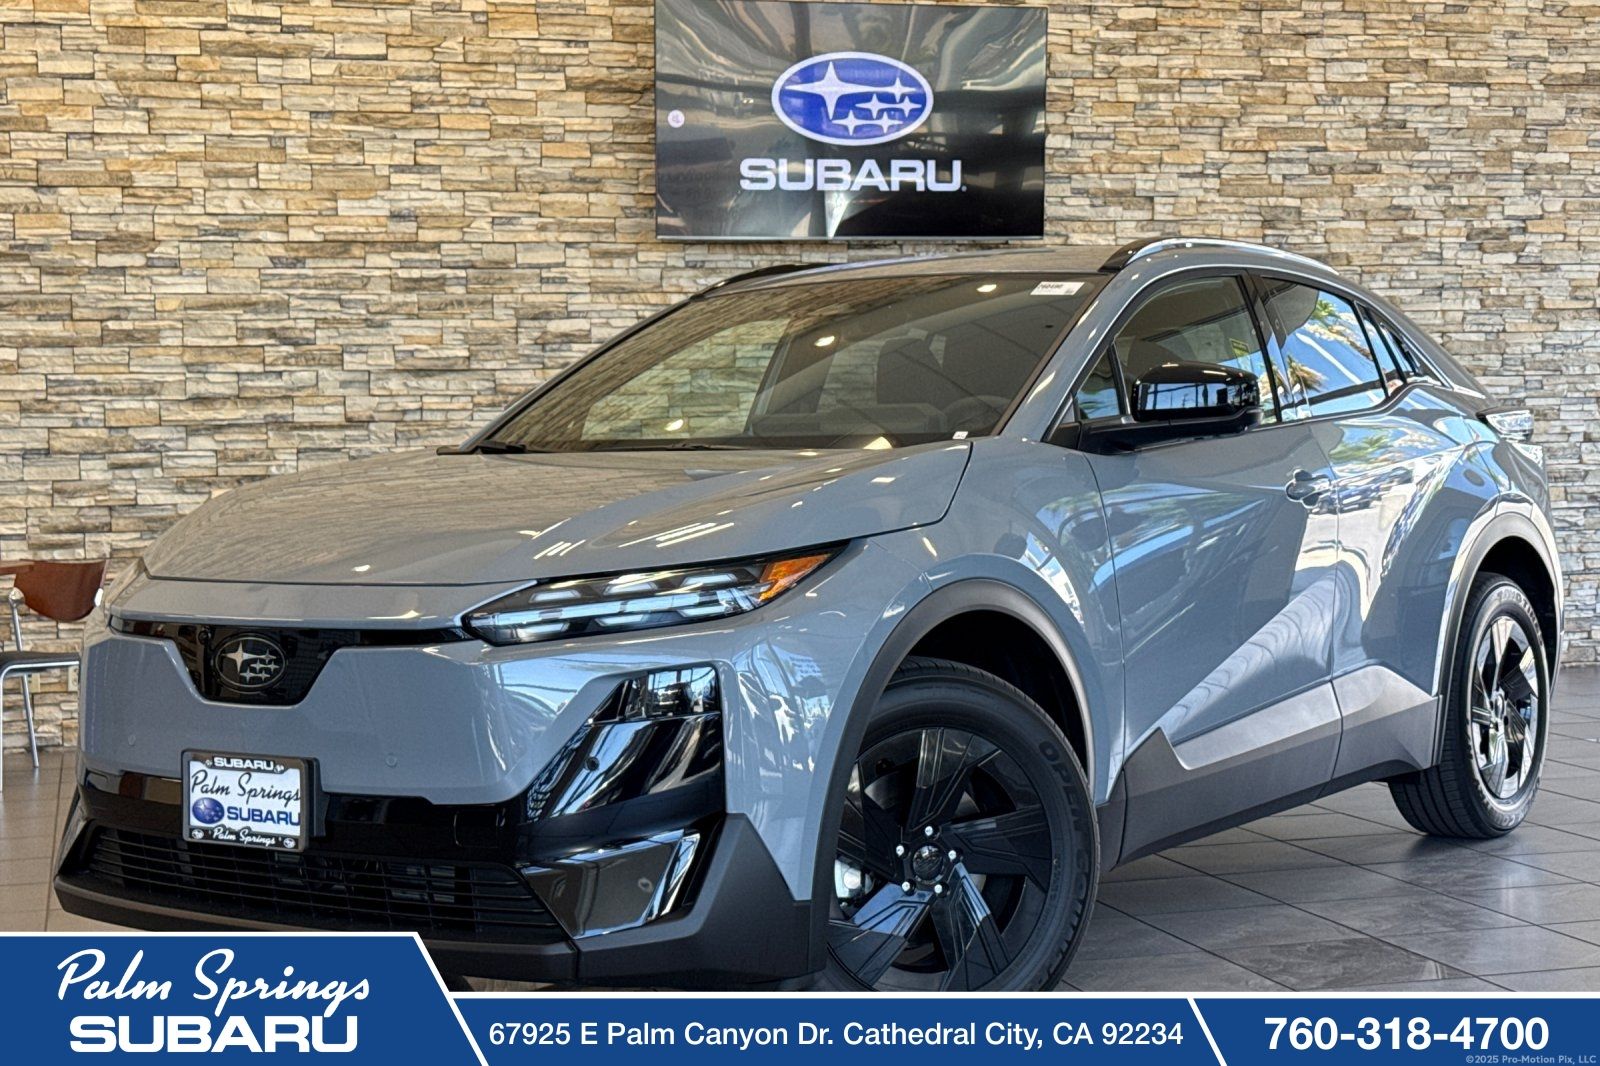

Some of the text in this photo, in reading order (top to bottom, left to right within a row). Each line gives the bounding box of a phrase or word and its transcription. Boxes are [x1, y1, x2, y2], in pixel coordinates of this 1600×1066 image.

[739, 158, 962, 191] SUBARU
[213, 757, 274, 770] SUBARU
[191, 769, 301, 808] Palm Springs
[227, 806, 301, 826] SUBARU
[213, 827, 276, 847] Palm Springs
